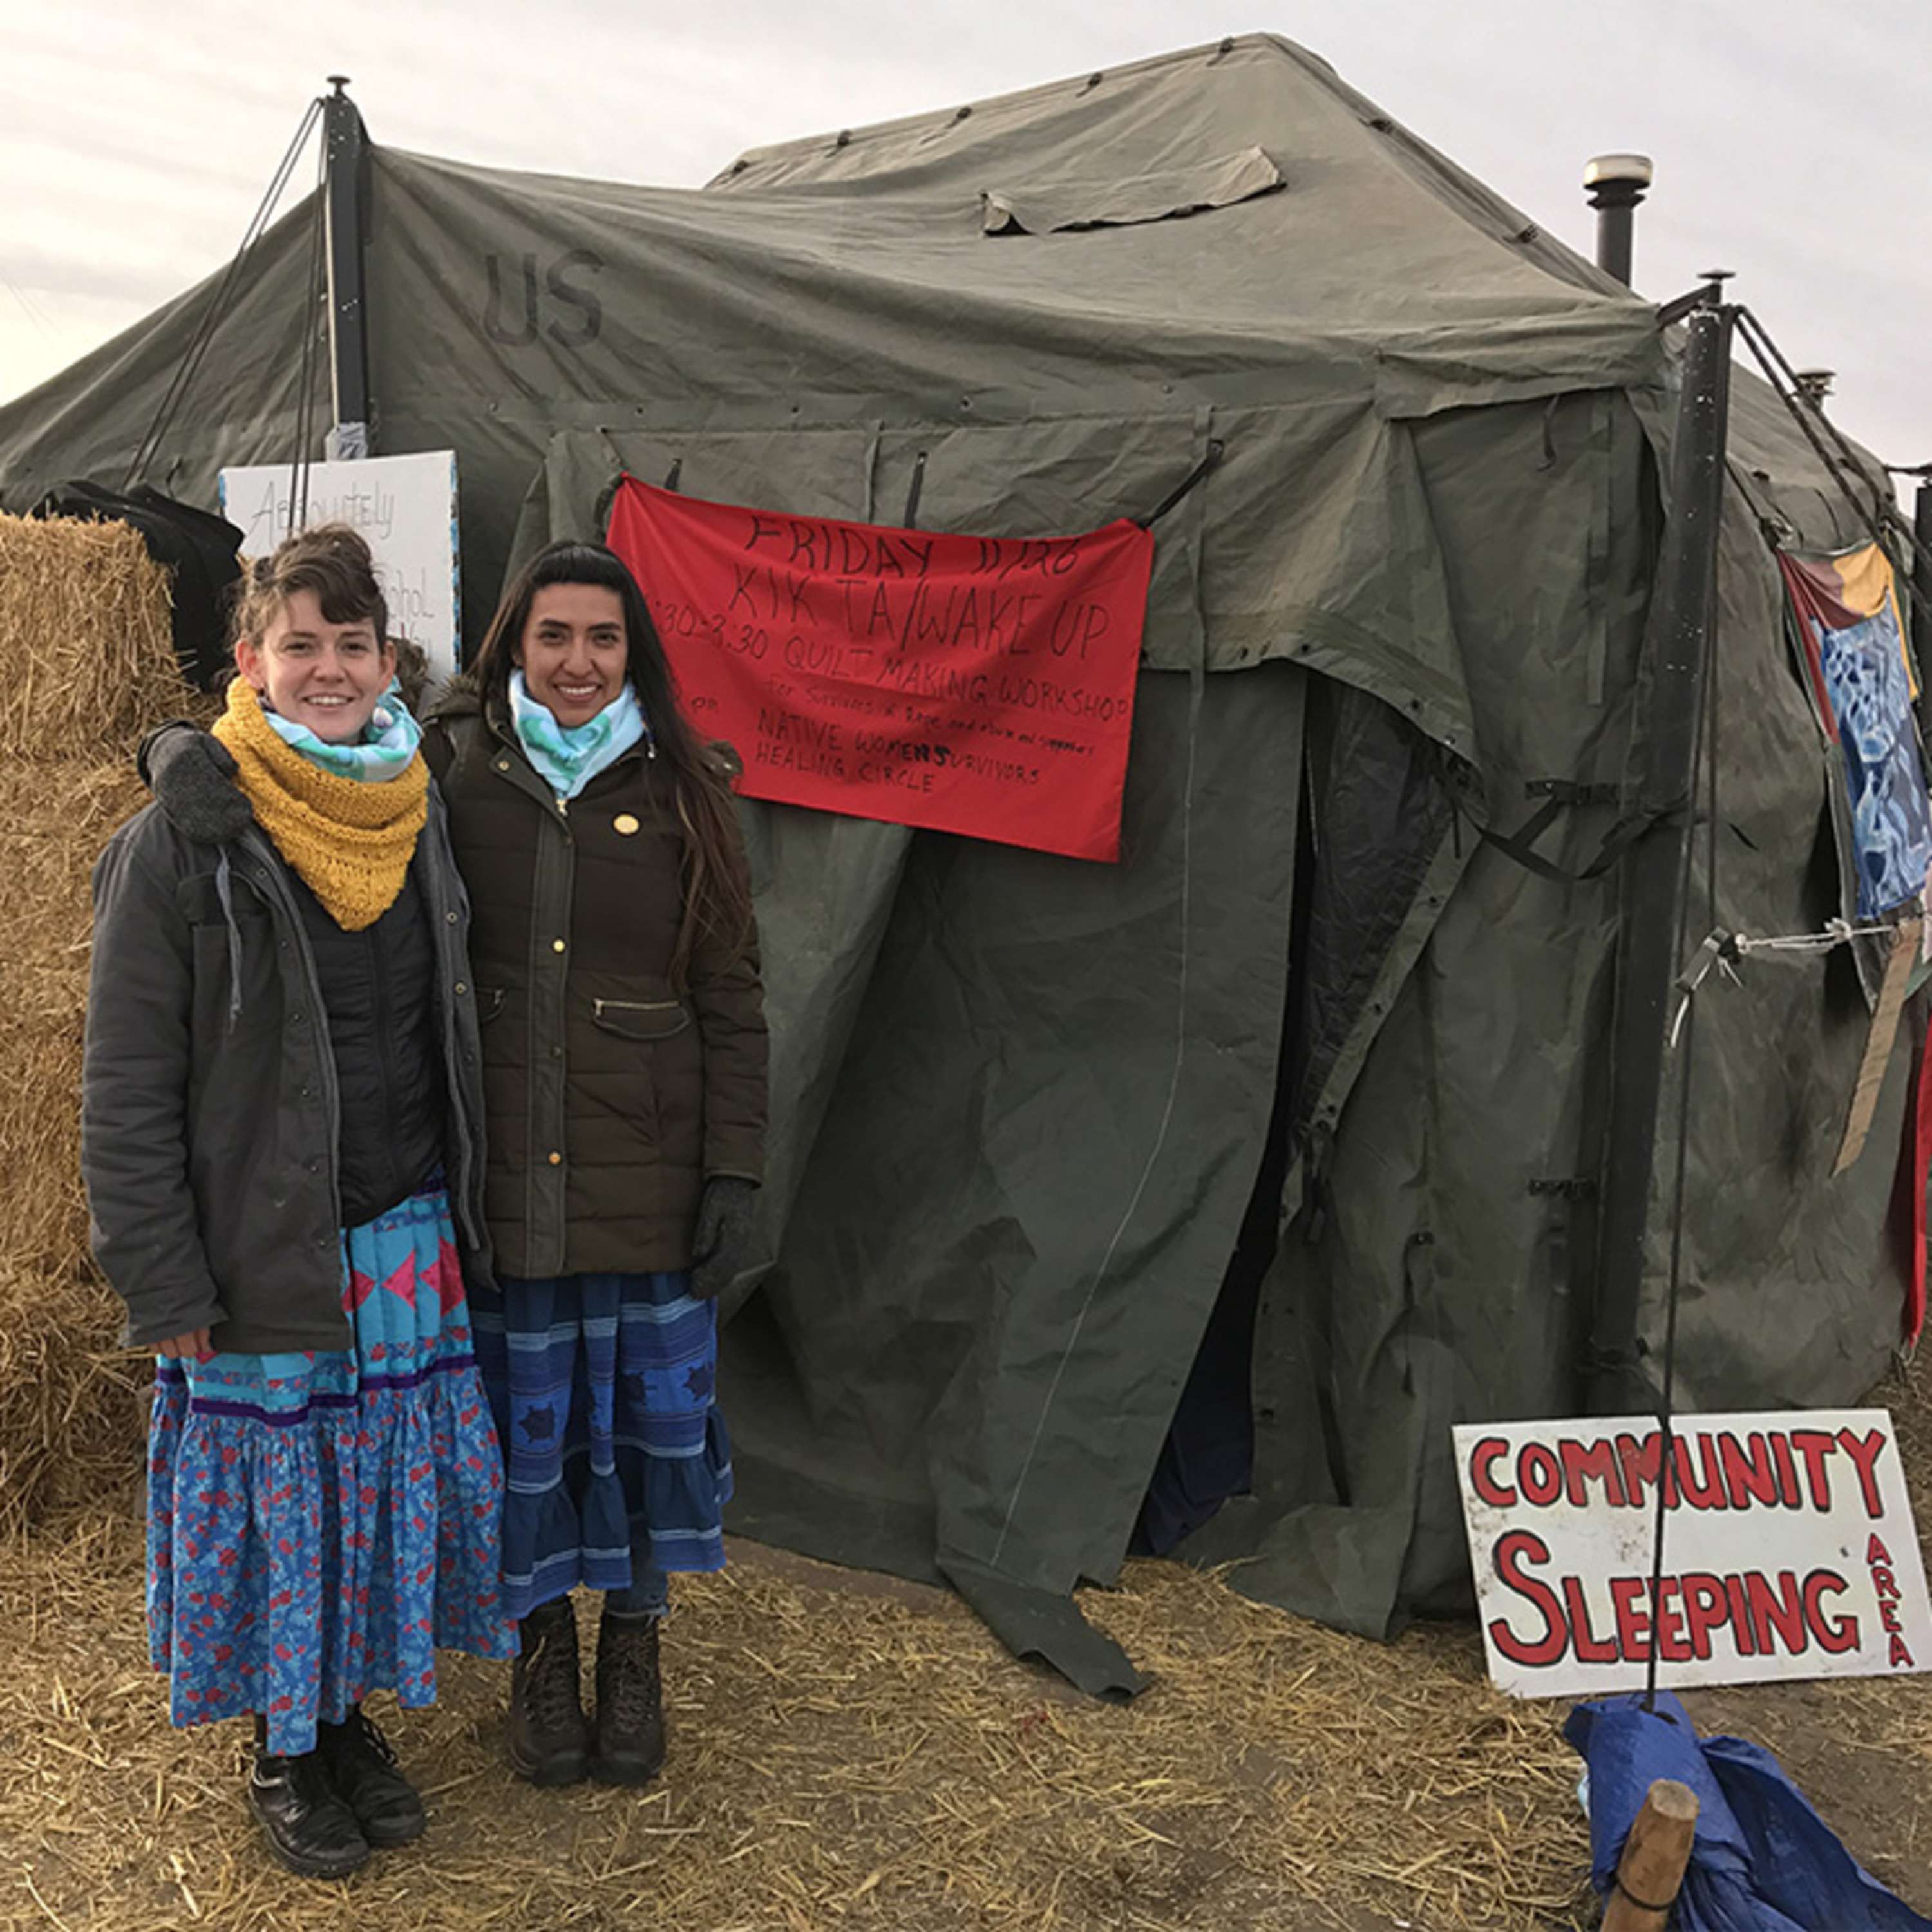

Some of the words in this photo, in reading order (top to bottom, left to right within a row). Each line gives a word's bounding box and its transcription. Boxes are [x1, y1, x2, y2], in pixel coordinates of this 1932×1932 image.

[484, 249, 605, 347] US
[744, 515, 933, 578] FRIDAY
[1050, 598, 1110, 659] UP
[784, 635, 873, 677] QUILT
[876, 657, 989, 705] MAKING
[757, 706, 842, 752] NATIVE
[754, 741, 845, 778] HEALING
[857, 762, 936, 794] CIRCLE
[1470, 1426, 1887, 1520] COMMUNITY
[1488, 1529, 1862, 1668] SLEEPING
[1865, 1532, 1917, 1669] AREA
